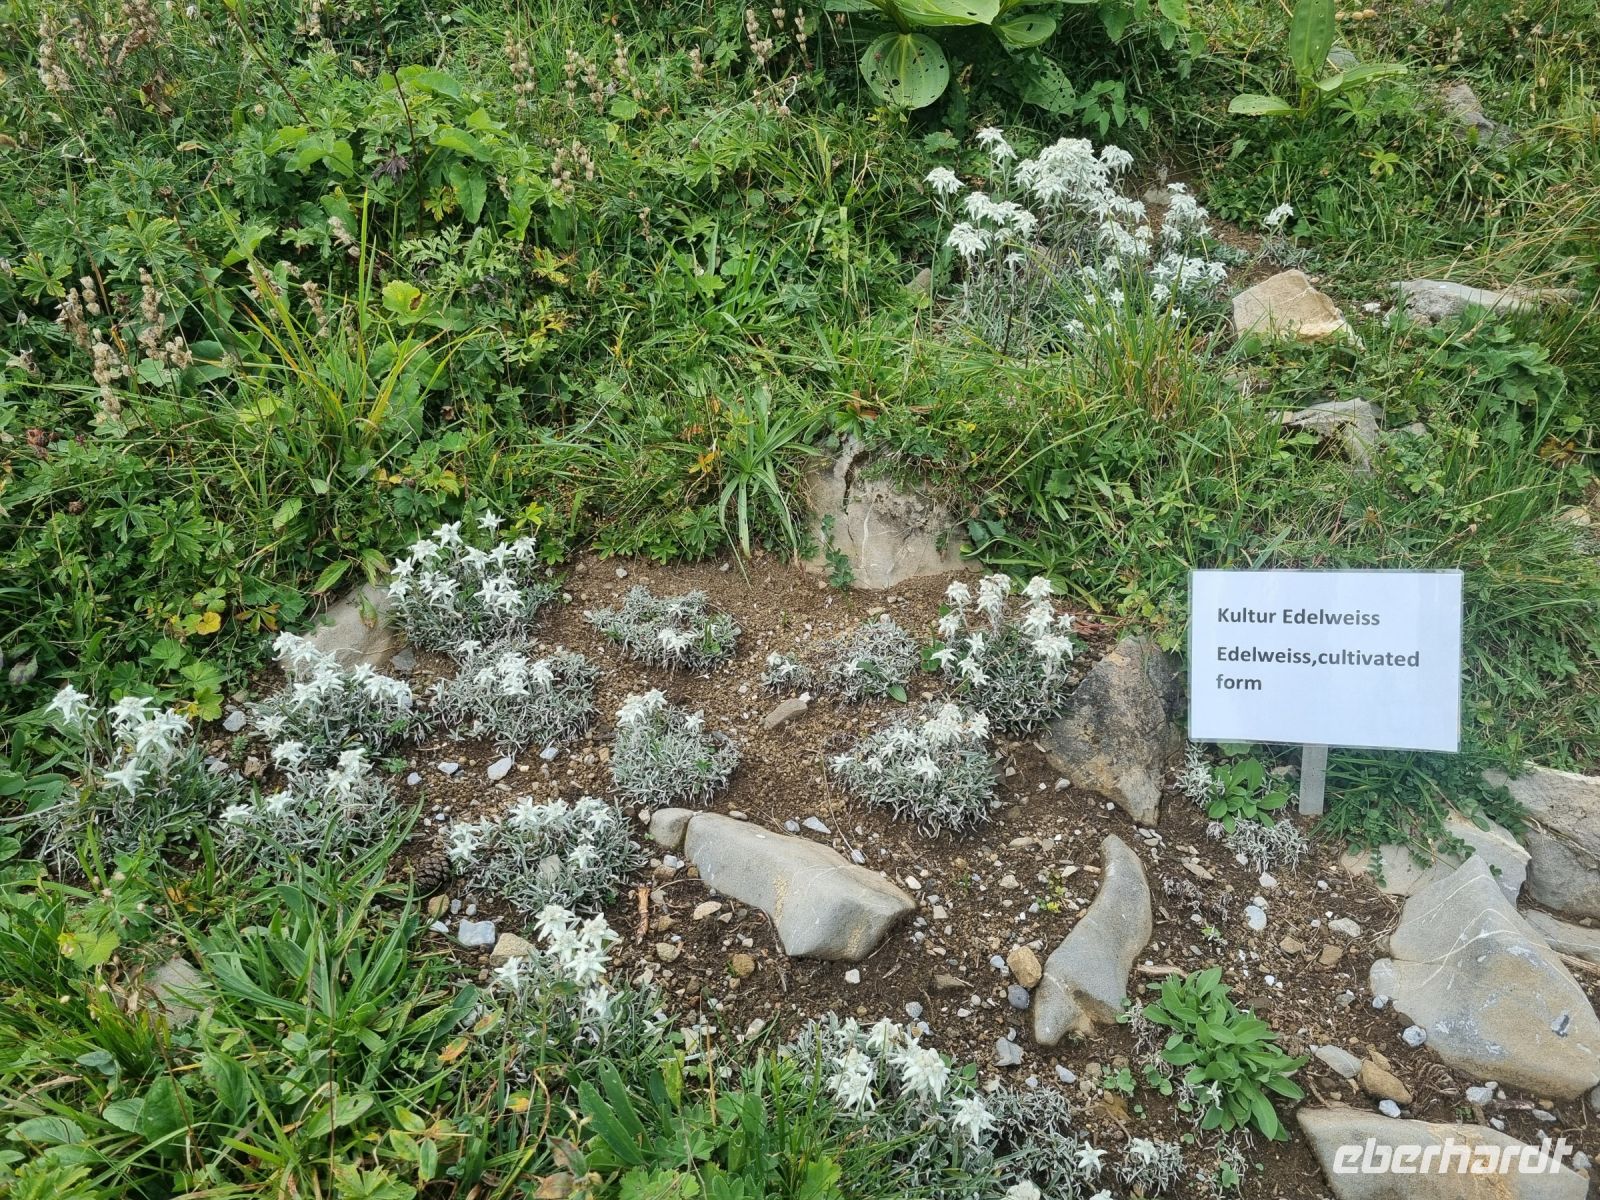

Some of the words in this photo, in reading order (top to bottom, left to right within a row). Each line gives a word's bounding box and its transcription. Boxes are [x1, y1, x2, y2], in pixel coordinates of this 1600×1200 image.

[1217, 607, 1277, 624] Kultur
[1283, 608, 1380, 626] Edelweiss
[1216, 674, 1262, 690] form
